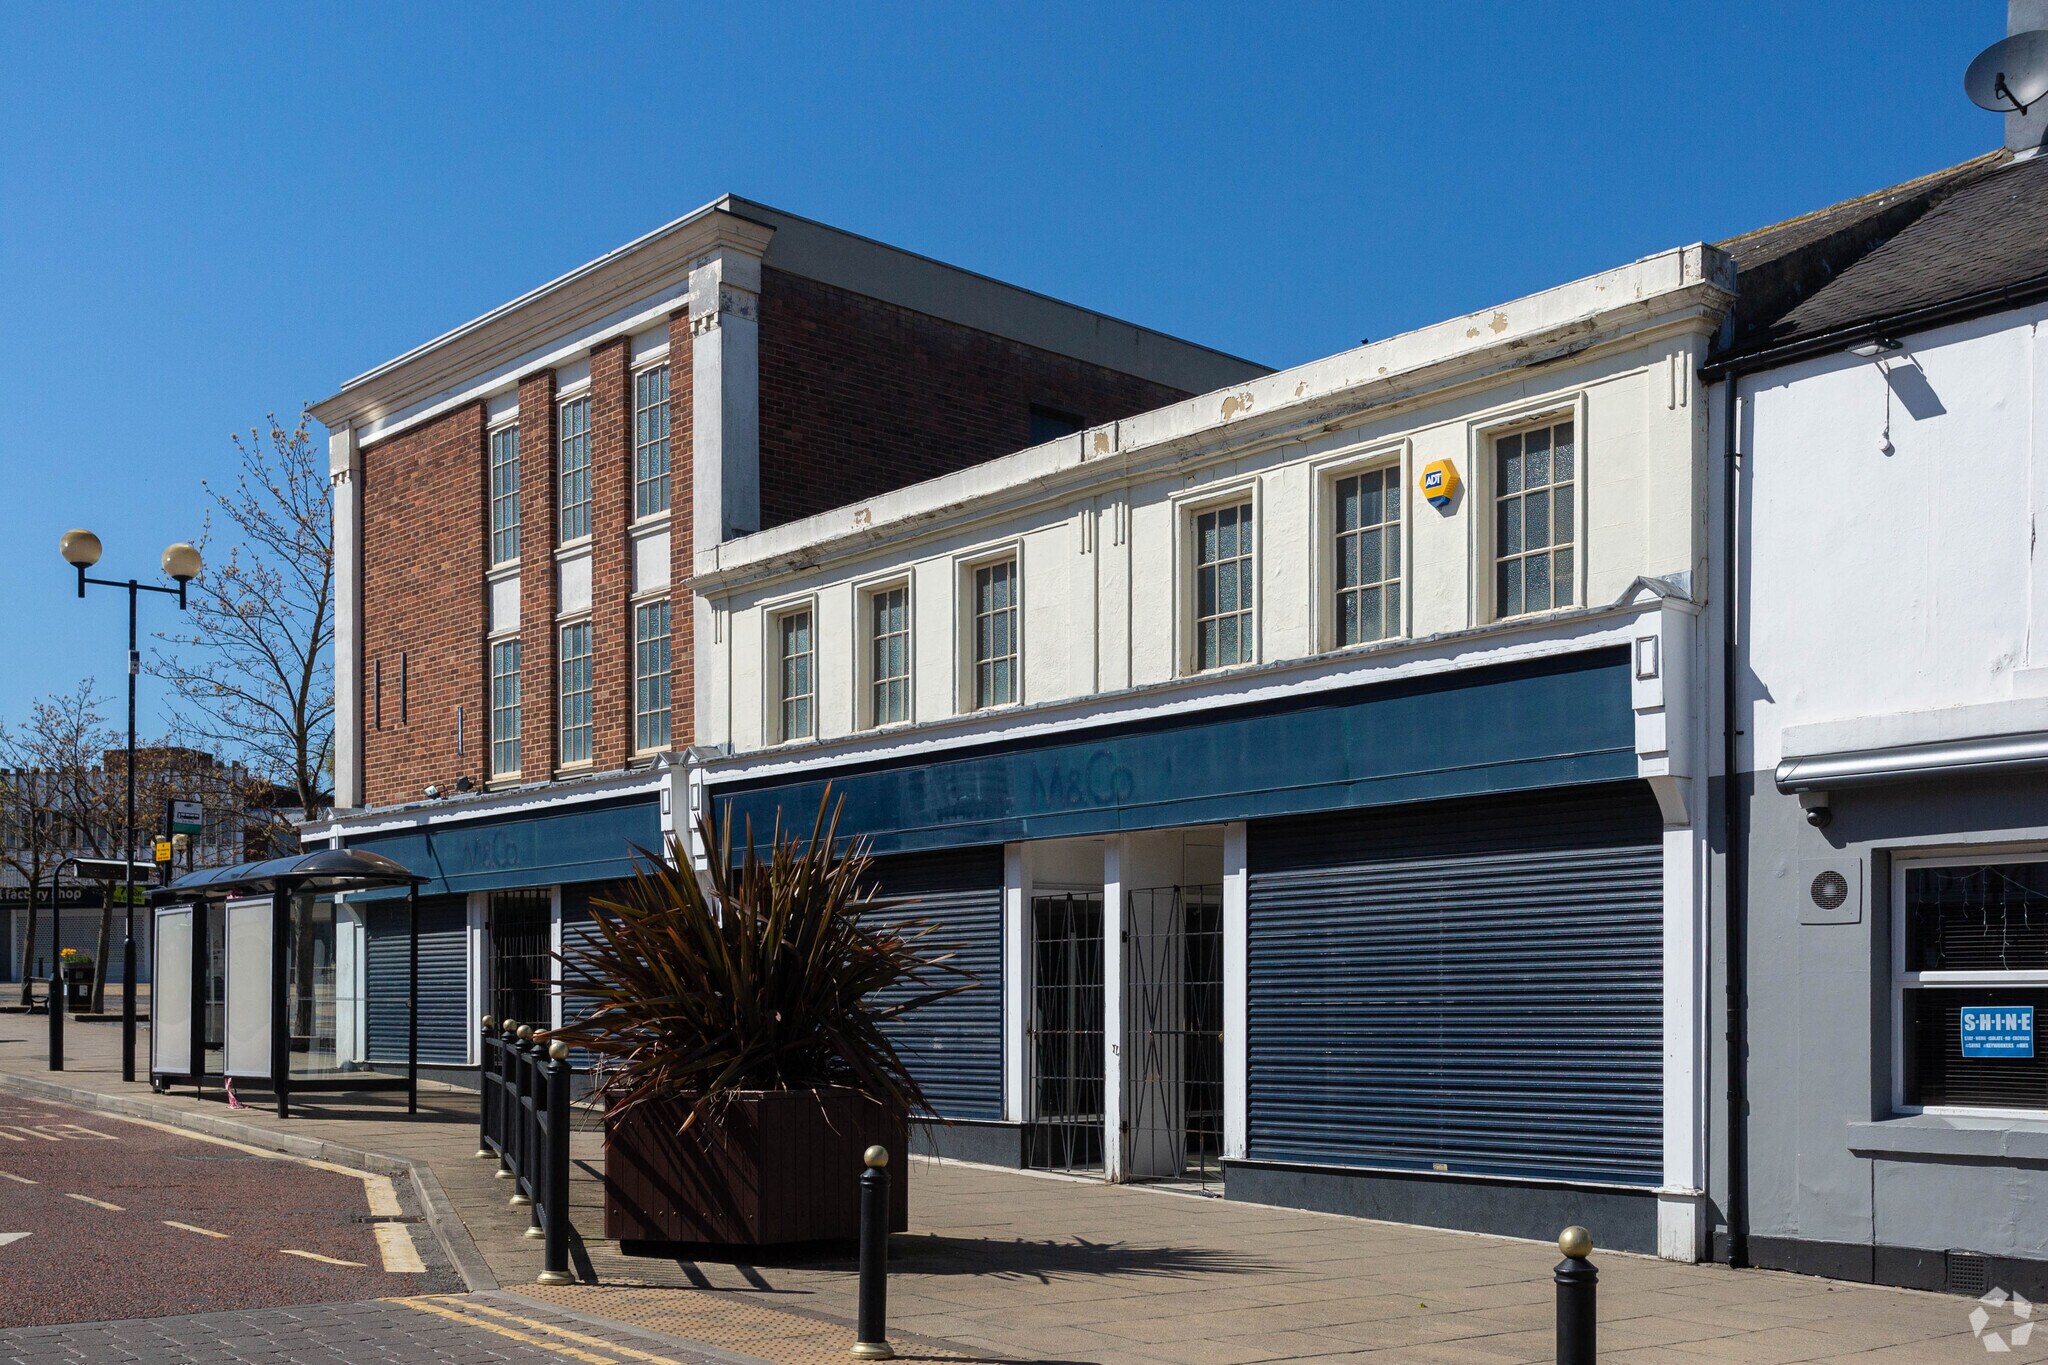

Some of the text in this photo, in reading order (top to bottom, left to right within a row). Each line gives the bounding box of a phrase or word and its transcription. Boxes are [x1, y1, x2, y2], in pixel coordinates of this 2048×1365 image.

[1426, 473, 1442, 487] ADT
[1029, 749, 1135, 810] M&Co
[464, 830, 519, 869] M&Co
[5, 888, 49, 902] factry
[52, 888, 82, 902] hop
